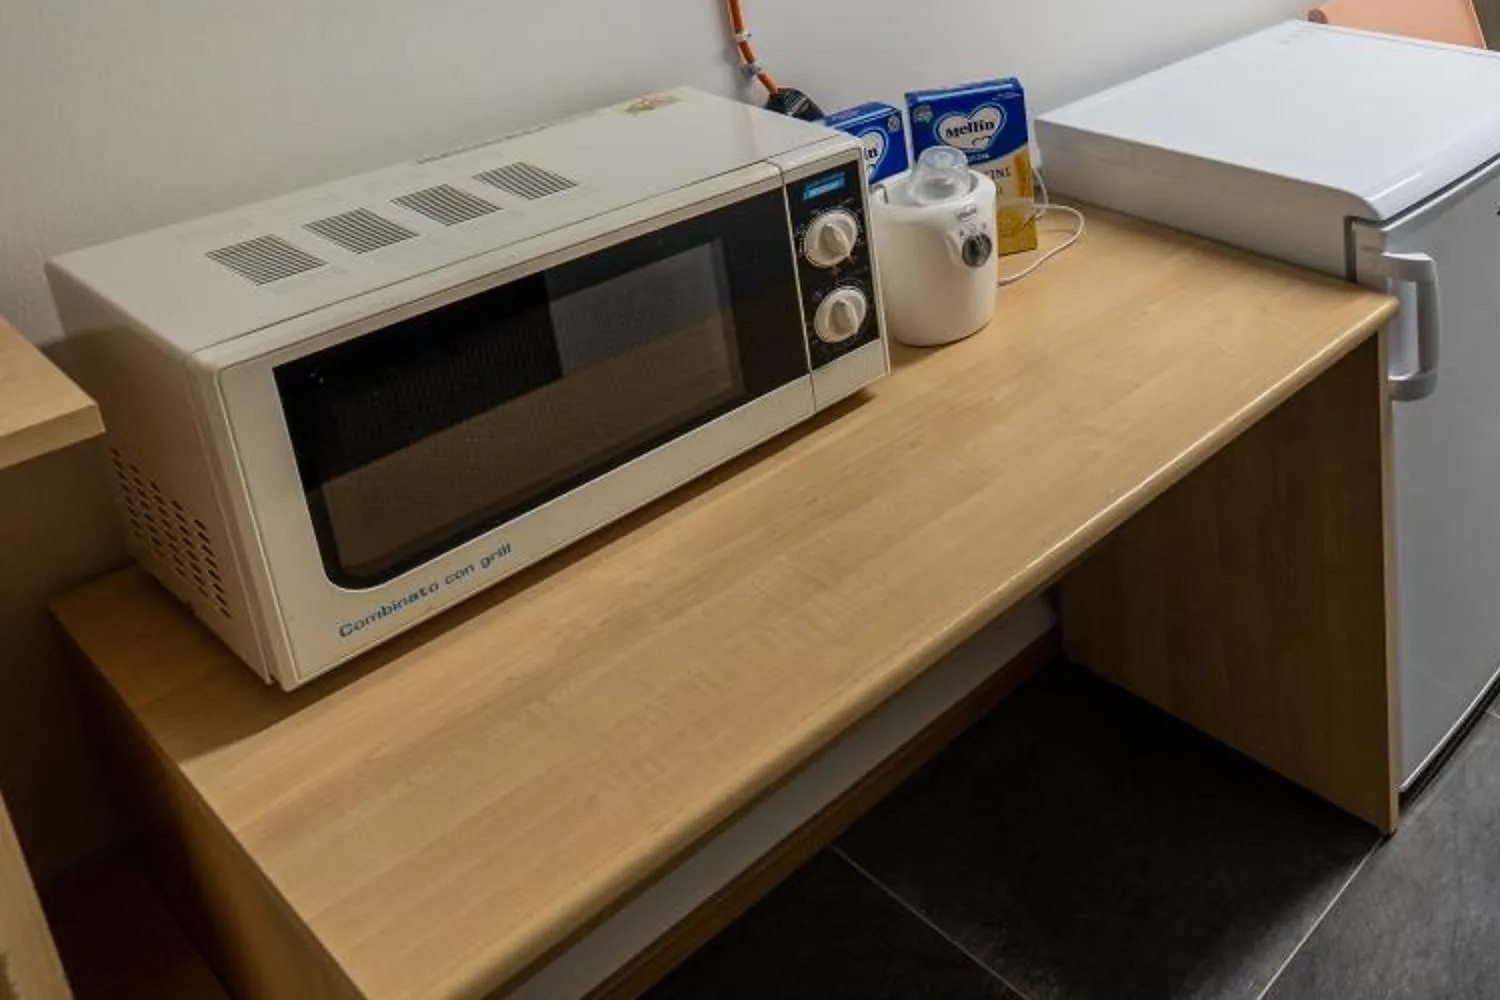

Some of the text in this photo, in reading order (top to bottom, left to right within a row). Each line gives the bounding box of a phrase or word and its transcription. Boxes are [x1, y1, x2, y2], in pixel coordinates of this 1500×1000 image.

[945, 119, 995, 138] Mellin
[338, 542, 512, 638] Combinato con grill
